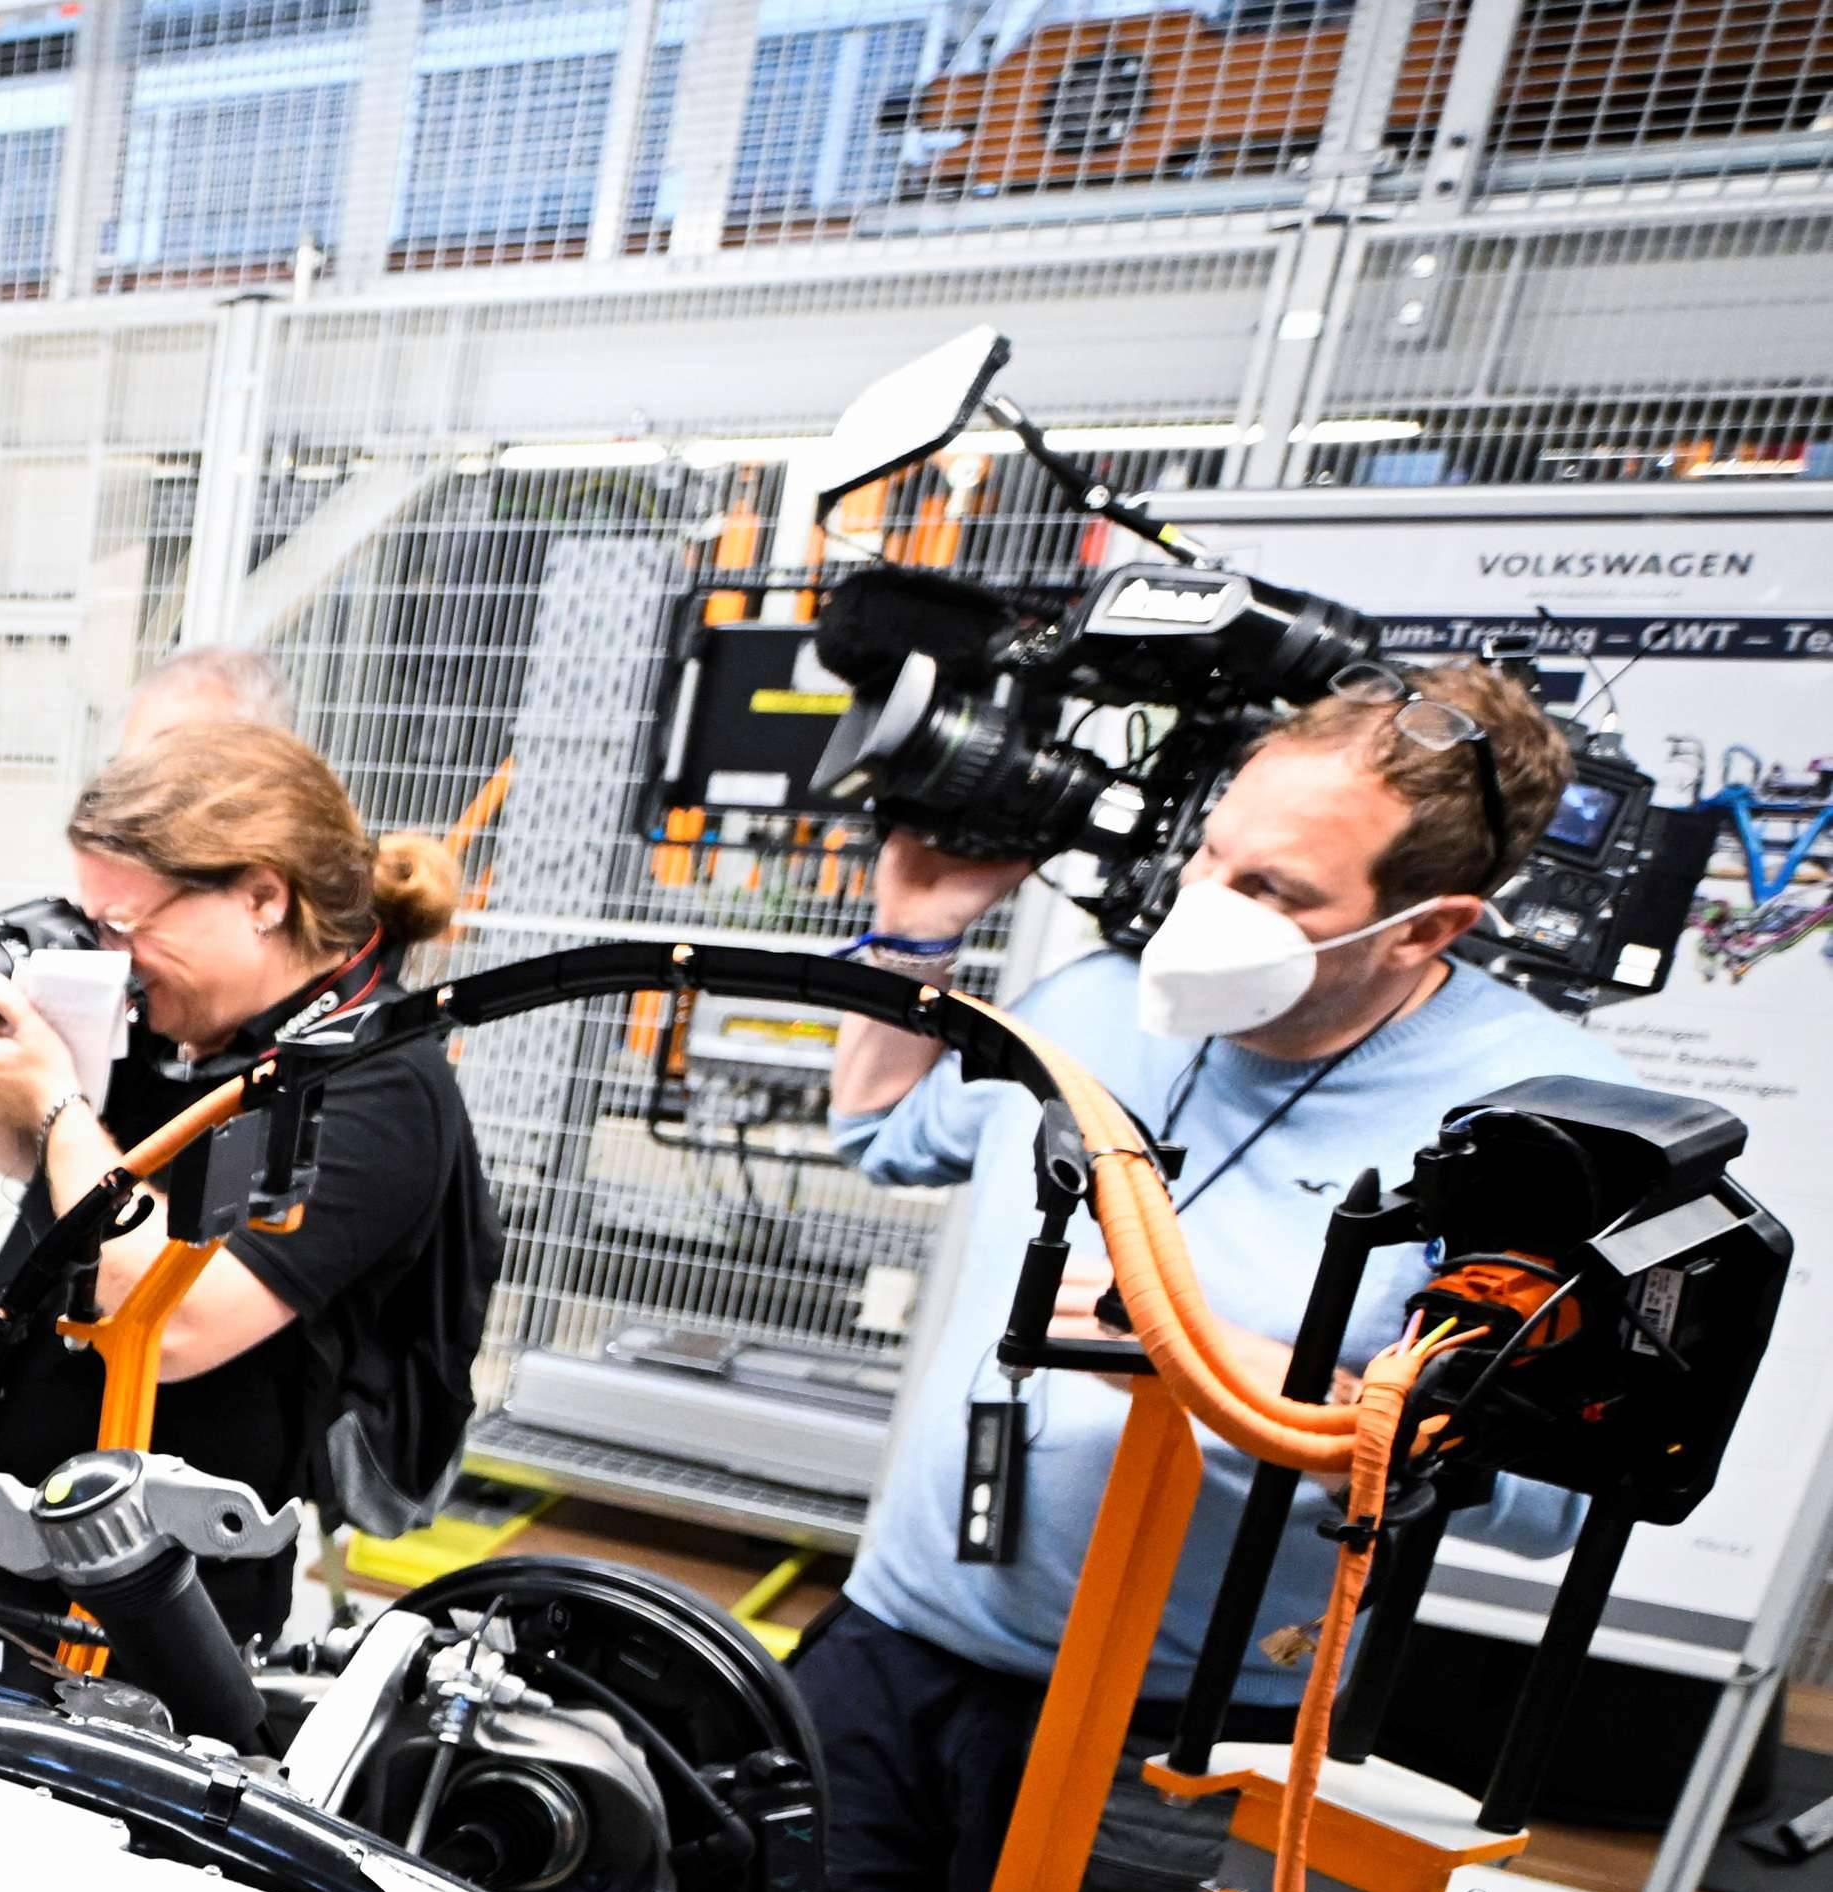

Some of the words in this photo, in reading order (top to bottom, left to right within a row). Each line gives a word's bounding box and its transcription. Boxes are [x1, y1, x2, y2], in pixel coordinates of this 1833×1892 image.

[1478, 552, 1754, 577] VOLKSWAGEN
[1638, 620, 1740, 651] GWT
[1783, 622, 1833, 652] Te
